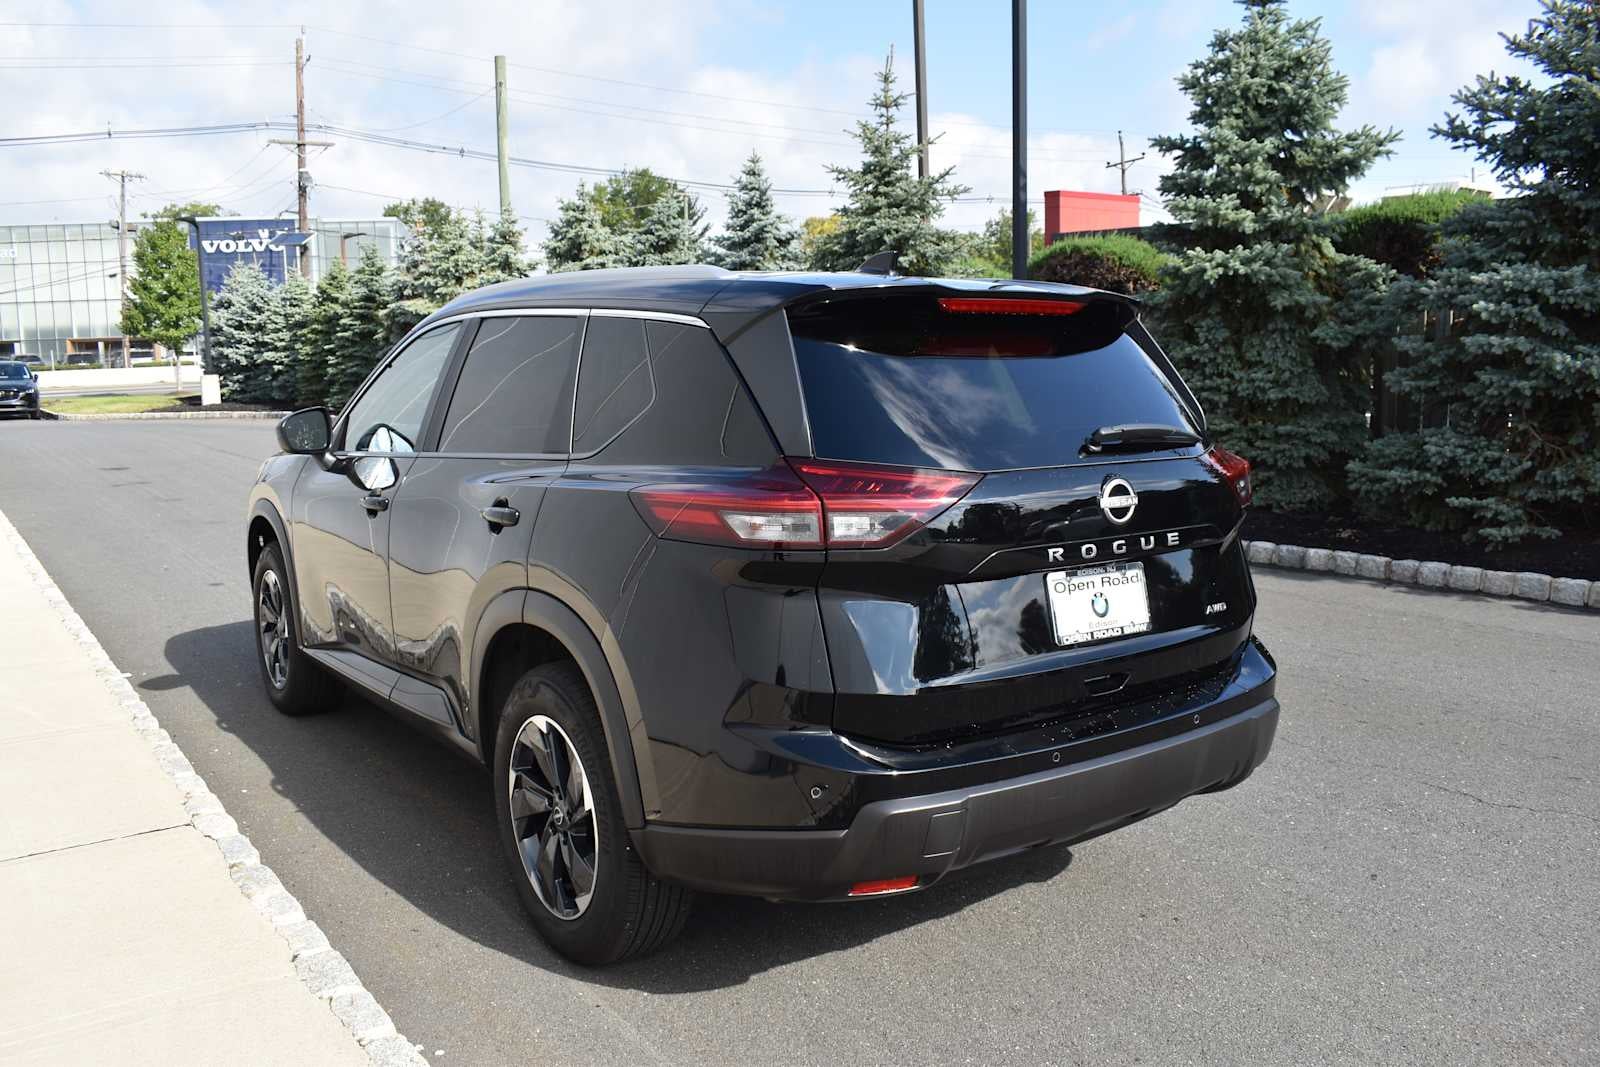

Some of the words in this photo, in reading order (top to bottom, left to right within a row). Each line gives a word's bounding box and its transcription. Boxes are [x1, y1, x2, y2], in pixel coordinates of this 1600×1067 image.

[1048, 532, 1180, 562] ROGUE
[1053, 580, 1095, 595] Open
[1101, 573, 1139, 588] Road
[1205, 602, 1227, 615] AWD
[1093, 627, 1121, 640] ROAD
